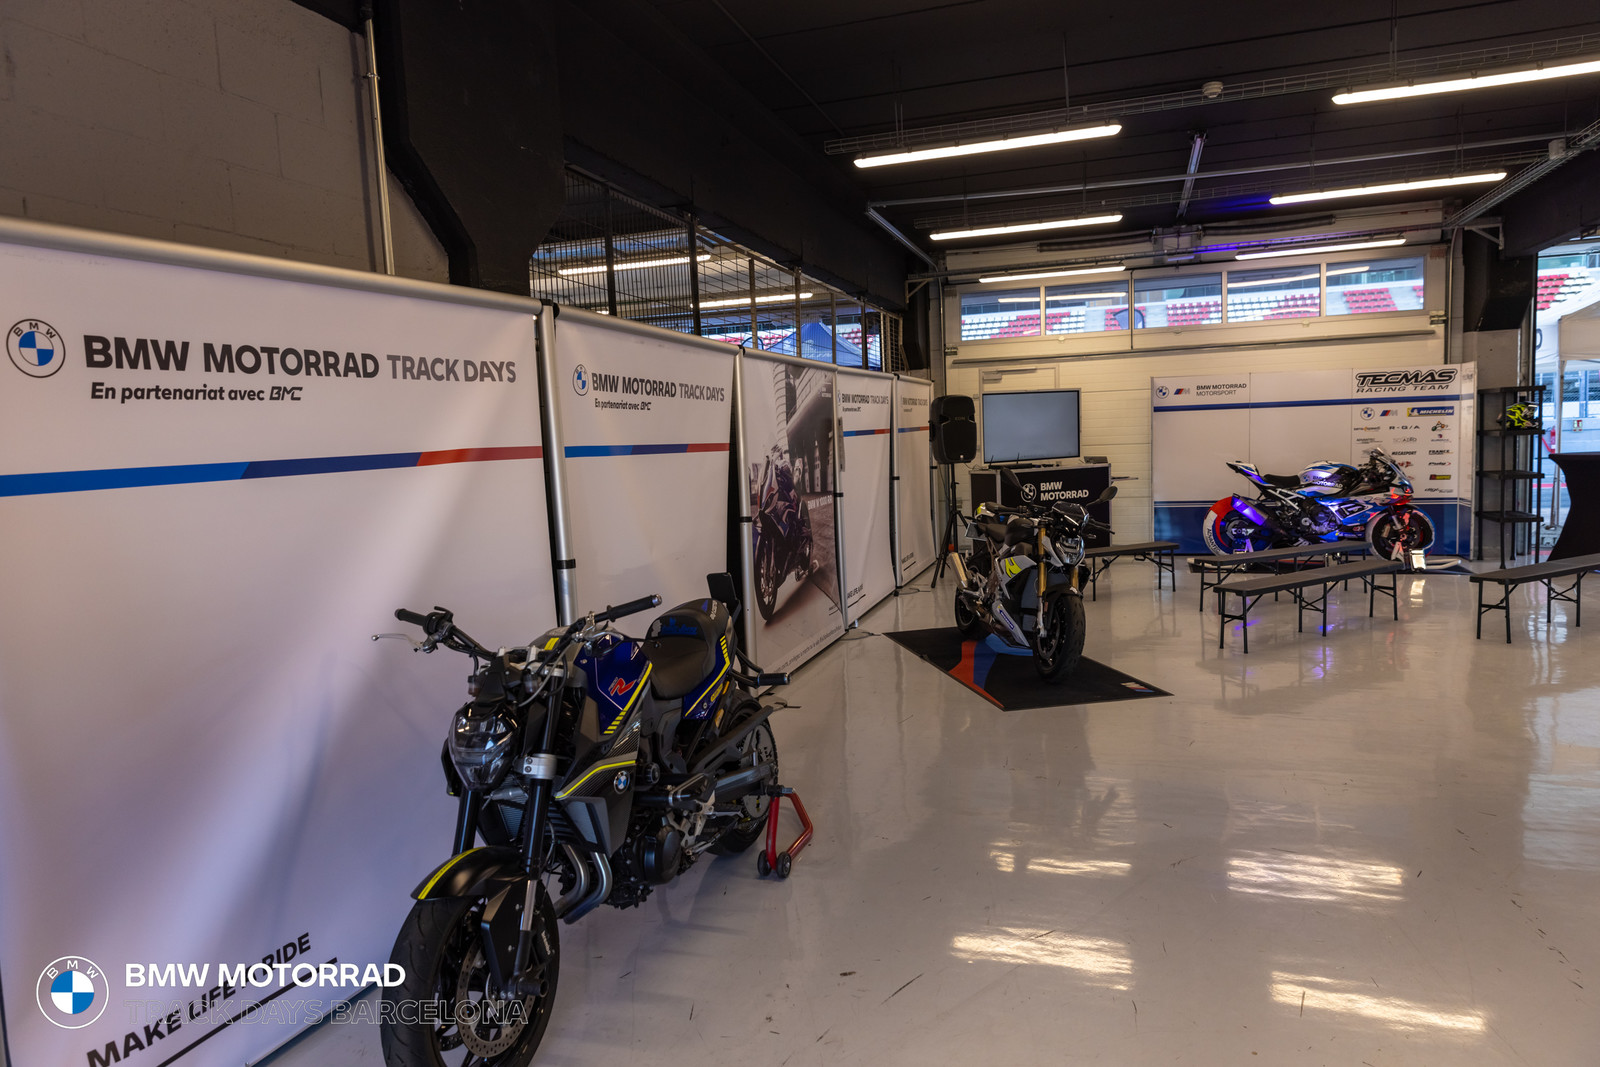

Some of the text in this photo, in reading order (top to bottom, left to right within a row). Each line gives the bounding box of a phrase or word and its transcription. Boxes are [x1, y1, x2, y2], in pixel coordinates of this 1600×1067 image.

[13, 321, 57, 339] BMW
[83, 334, 517, 383] BMW MOTORRAD TRACK DAYS
[591, 372, 725, 402] BMW MOTORRAD TRACK DAYS
[1356, 369, 1458, 387] TECMAS
[91, 382, 304, 404] En partenariat avec BMC
[601, 399, 628, 411] partenariat
[1040, 481, 1063, 491] BMW
[1040, 490, 1089, 501] MOTORRAD
[86, 1007, 182, 1067] MAKE
[188, 975, 237, 1022] LIFE
[261, 932, 312, 976] RIDE
